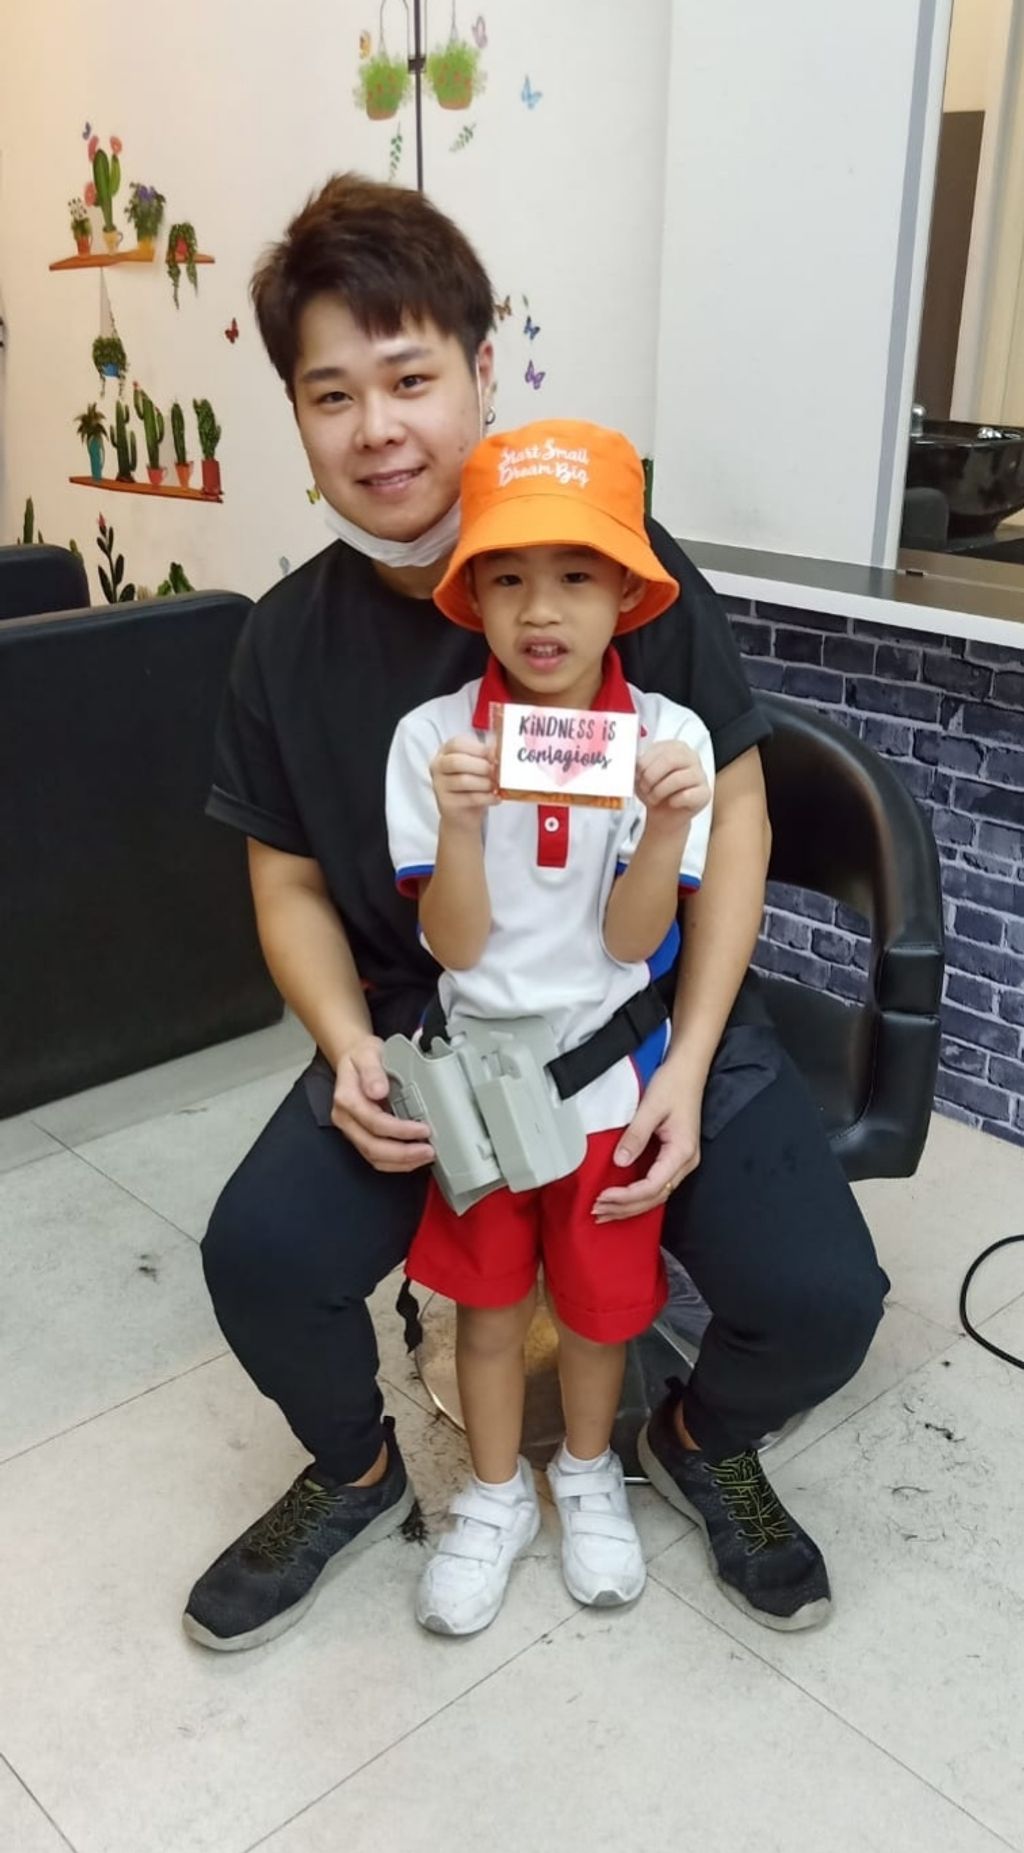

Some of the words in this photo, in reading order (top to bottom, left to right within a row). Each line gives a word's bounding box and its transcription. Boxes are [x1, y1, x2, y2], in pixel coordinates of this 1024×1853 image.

[500, 446, 540, 465] Start
[543, 438, 589, 464] Small
[499, 463, 553, 487] Dream
[555, 462, 589, 489] Big
[517, 745, 612, 773] contagious
